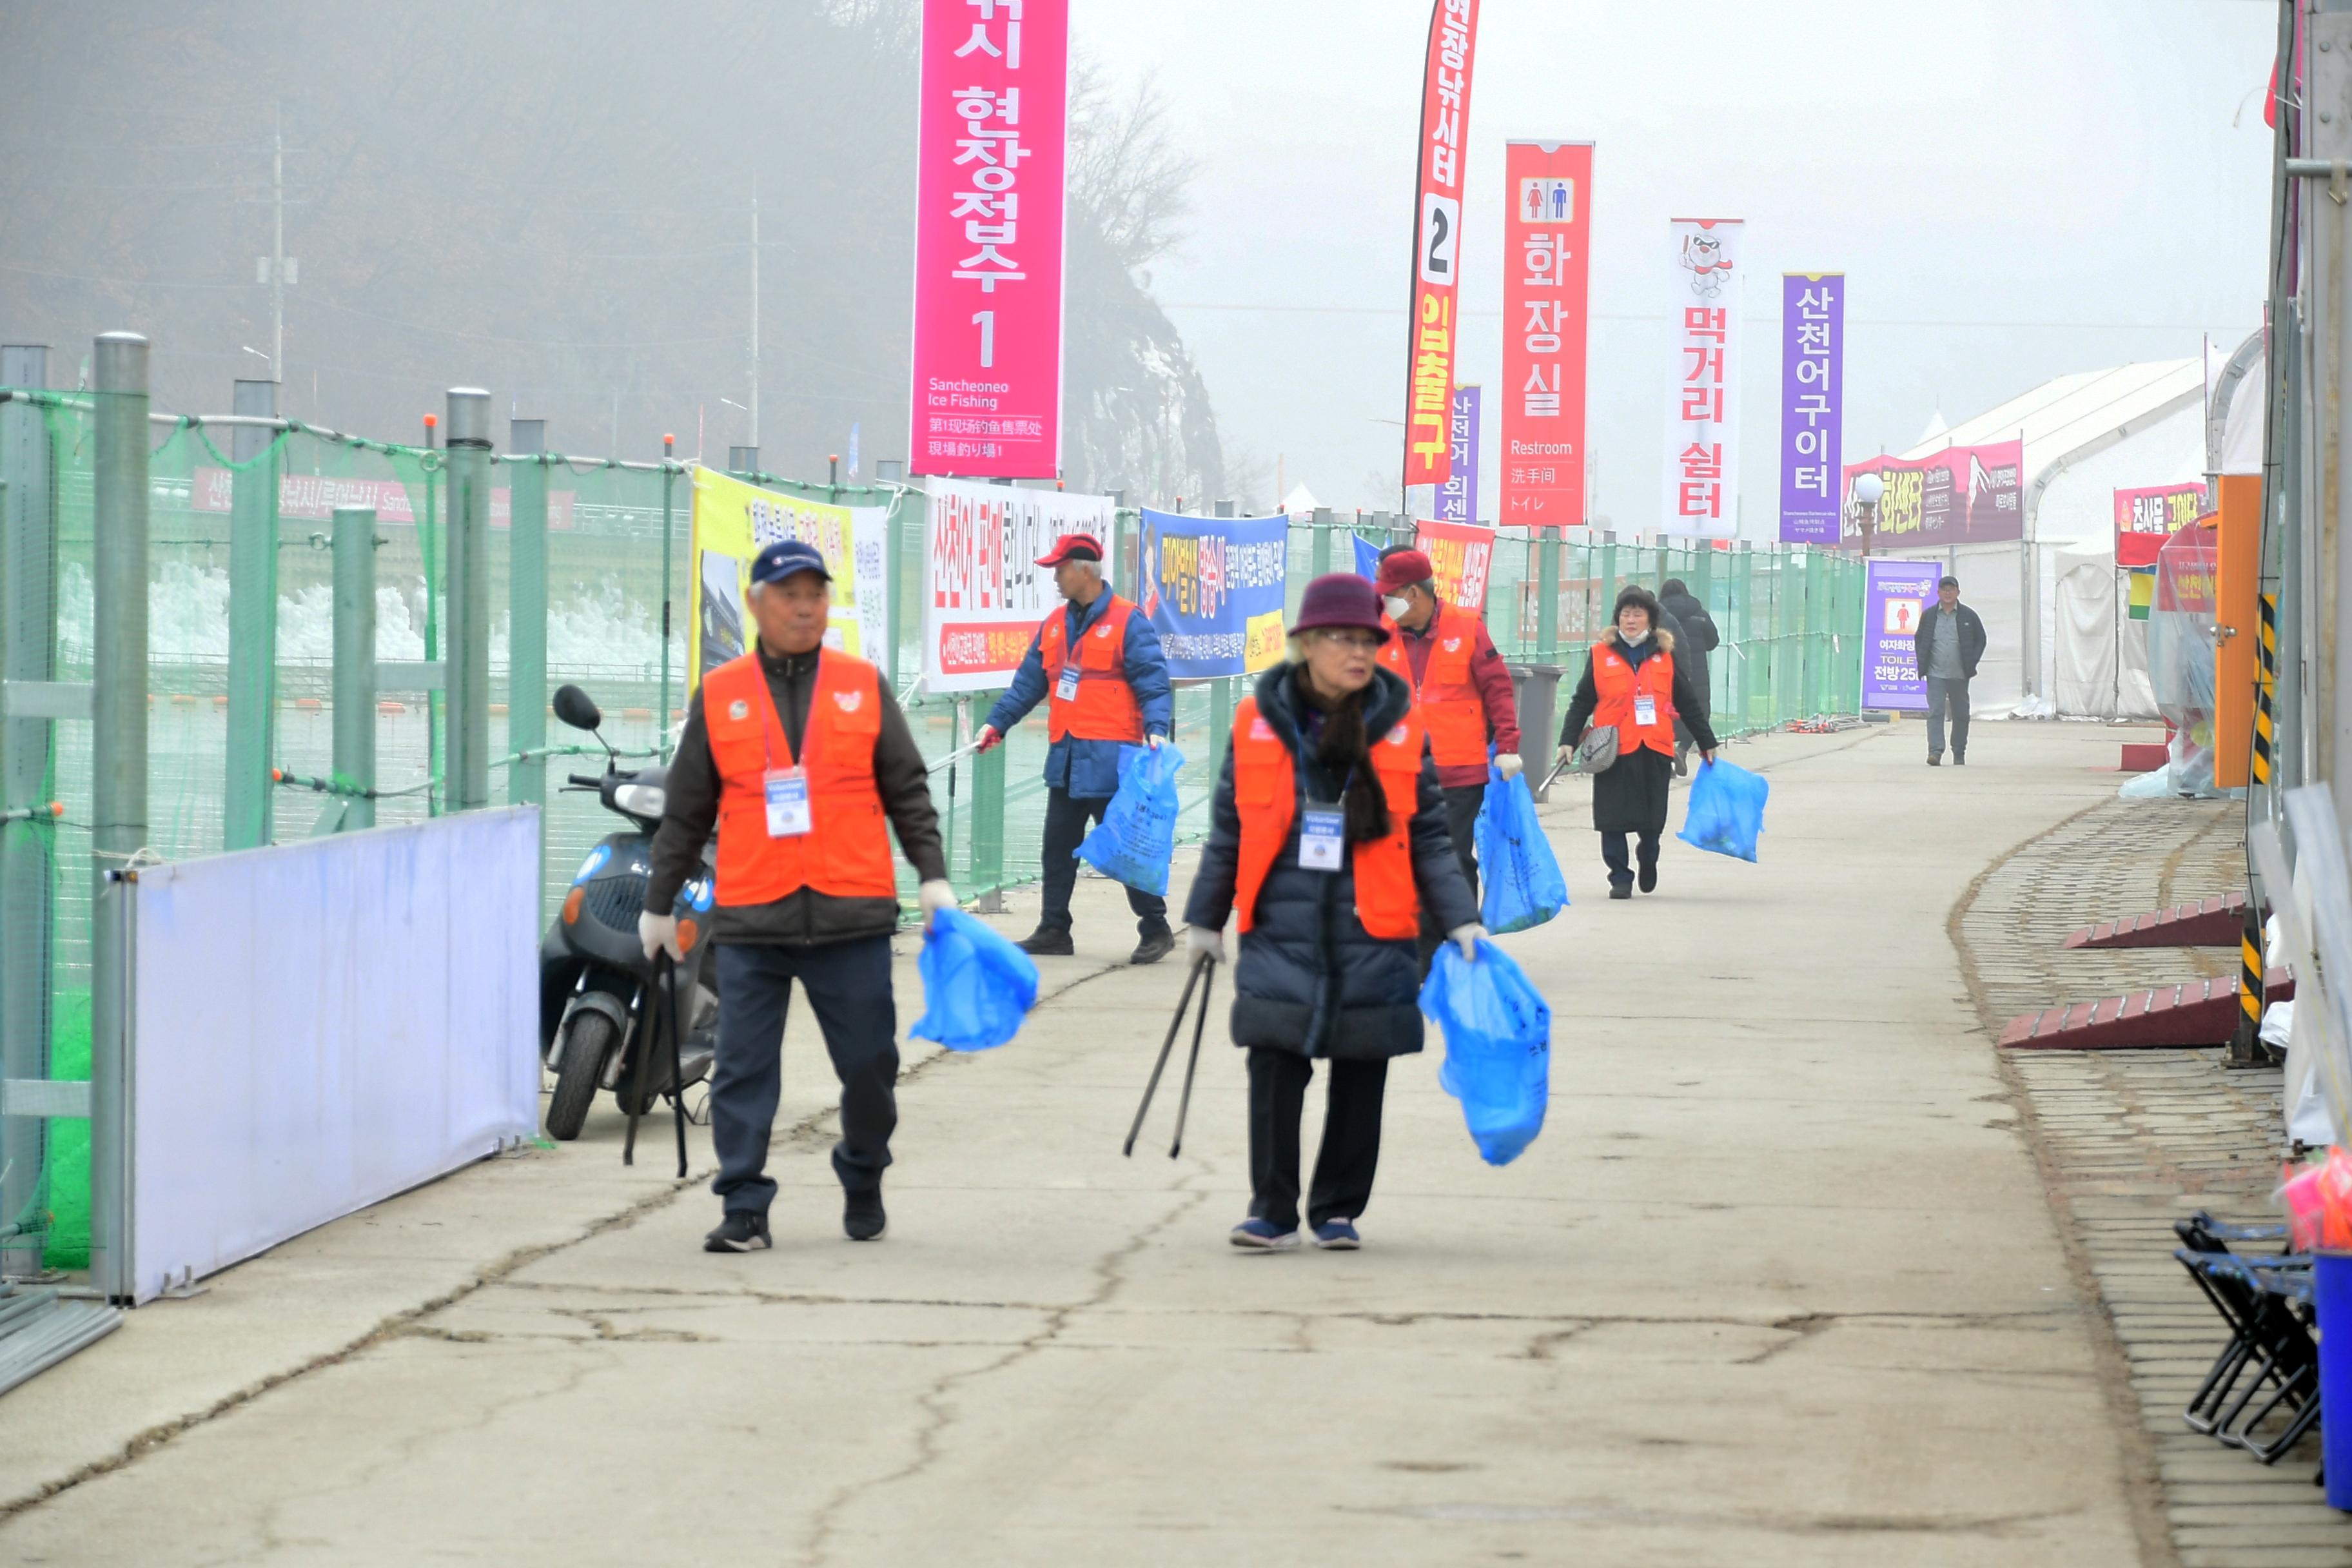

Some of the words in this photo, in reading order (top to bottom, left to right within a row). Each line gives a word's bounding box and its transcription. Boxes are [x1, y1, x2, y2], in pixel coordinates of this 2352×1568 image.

[950, 86, 1031, 293] 현장접수
[1428, 207, 1449, 274] 2
[971, 310, 994, 368] 1
[1524, 233, 1571, 416] 화장실
[929, 378, 1009, 393] Sancheoneo
[1413, 293, 1449, 470] 입출구
[1682, 307, 1726, 423] 먹거리
[1794, 287, 1834, 498] 산천어구이터
[928, 393, 947, 406] Ice
[951, 394, 997, 411] Fishing
[929, 418, 1042, 436] 第1现场钓鱼售票处
[1511, 440, 1572, 455] Restroom
[1511, 467, 1555, 484] 洗手间
[1442, 475, 1467, 524] 회센
[1511, 496, 1544, 511] トイレ
[1679, 442, 1722, 518] 쉼터
[1881, 471, 1924, 534] 회센터
[934, 494, 974, 611] 산천어
[978, 500, 1039, 611] 판매합니다
[1161, 536, 1198, 614] 미아발생
[1198, 534, 1226, 620] 방송시
[1874, 665, 1899, 681] 전방
[1879, 639, 1916, 651] 여자화장
[1880, 656, 1917, 665] TOILE
